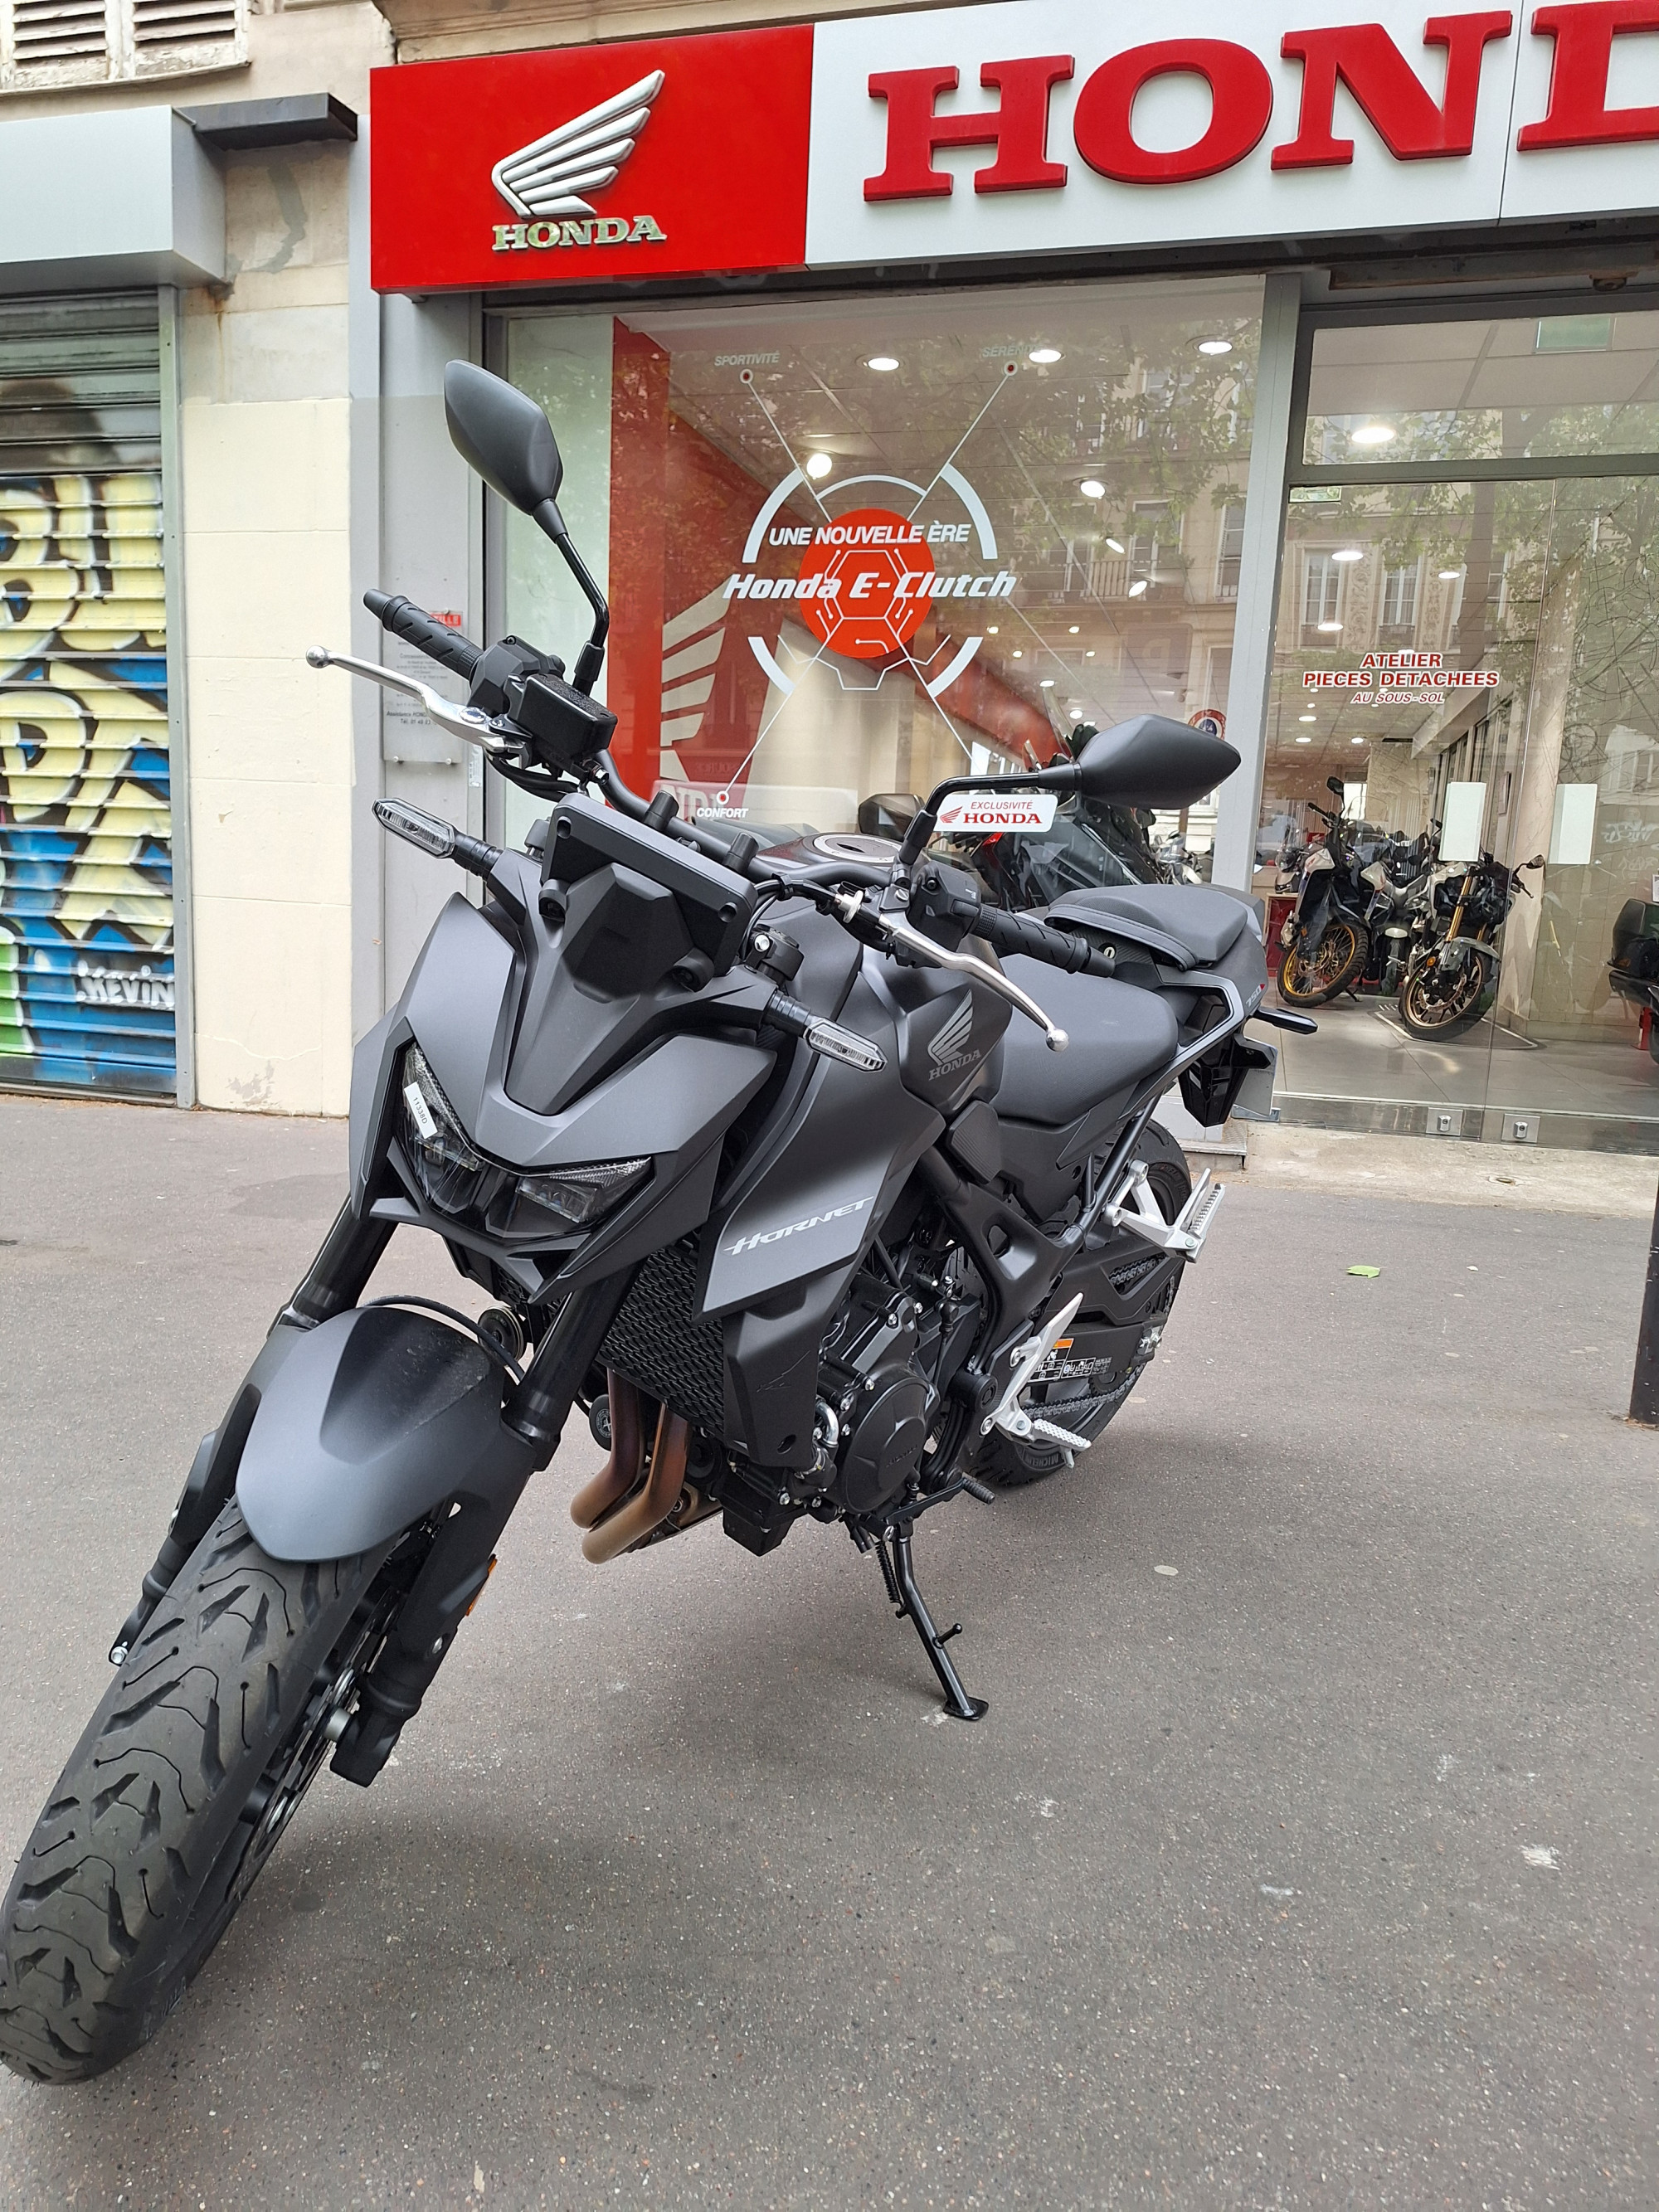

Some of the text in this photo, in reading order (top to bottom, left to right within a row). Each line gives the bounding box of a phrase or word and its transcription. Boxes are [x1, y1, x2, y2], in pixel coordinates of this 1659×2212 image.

[492, 215, 667, 250] HONDA
[714, 350, 780, 366] SPORTIVITÉ
[769, 520, 972, 546] UNE NOUVELLE ÈRE
[722, 573, 842, 599] Honda
[1360, 654, 1443, 668] ATELIER
[1303, 672, 1499, 687] PIECES DETACHEES
[1351, 692, 1374, 703] AU
[971, 800, 1034, 809] EXCLUSIVITÉ
[697, 807, 749, 819] CONFORT
[963, 813, 1043, 824] HONDA
[928, 1048, 981, 1082] HONDA
[413, 1096, 428, 1125] 11338D
[723, 1196, 874, 1256] HORNET
